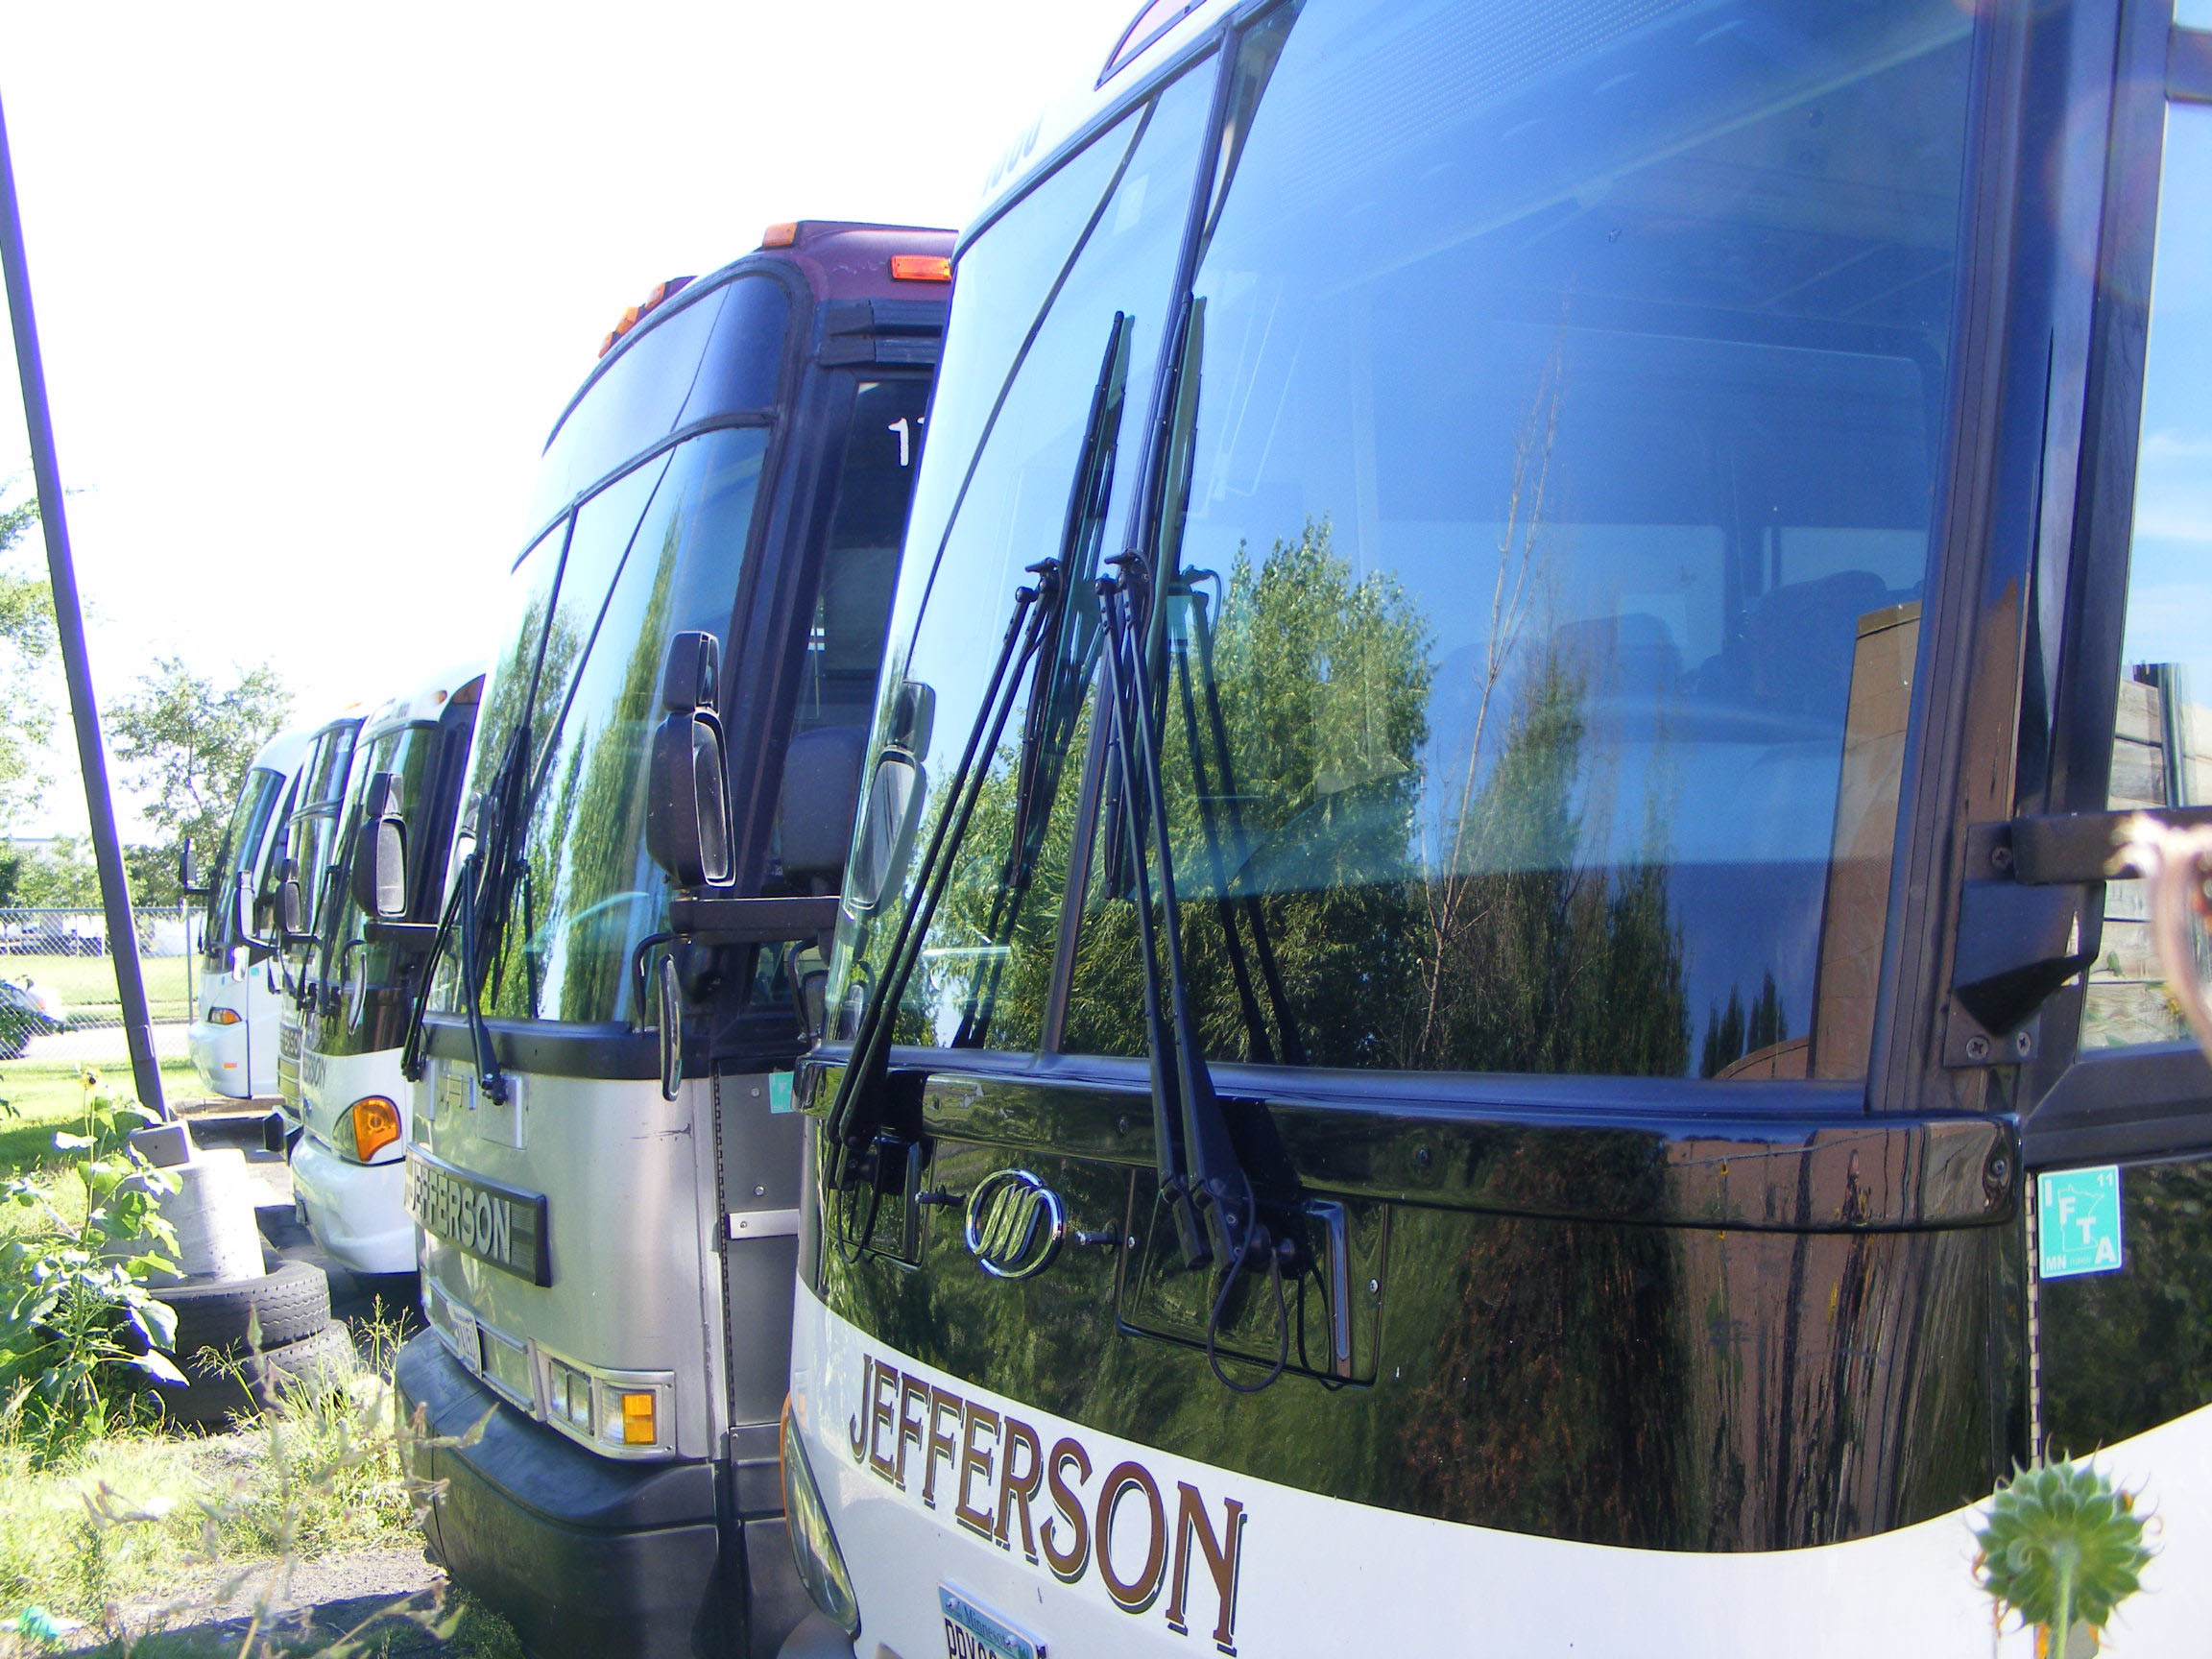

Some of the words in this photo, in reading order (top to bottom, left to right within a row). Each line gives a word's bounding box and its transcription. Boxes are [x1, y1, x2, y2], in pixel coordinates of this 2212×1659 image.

[888, 417, 925, 467] 1
[2097, 1173, 2113, 1187] 11
[407, 1159, 511, 1265] JEFFERSON
[2046, 1254, 2066, 1271] MN
[849, 1353, 1248, 1658] JEFFERSON
